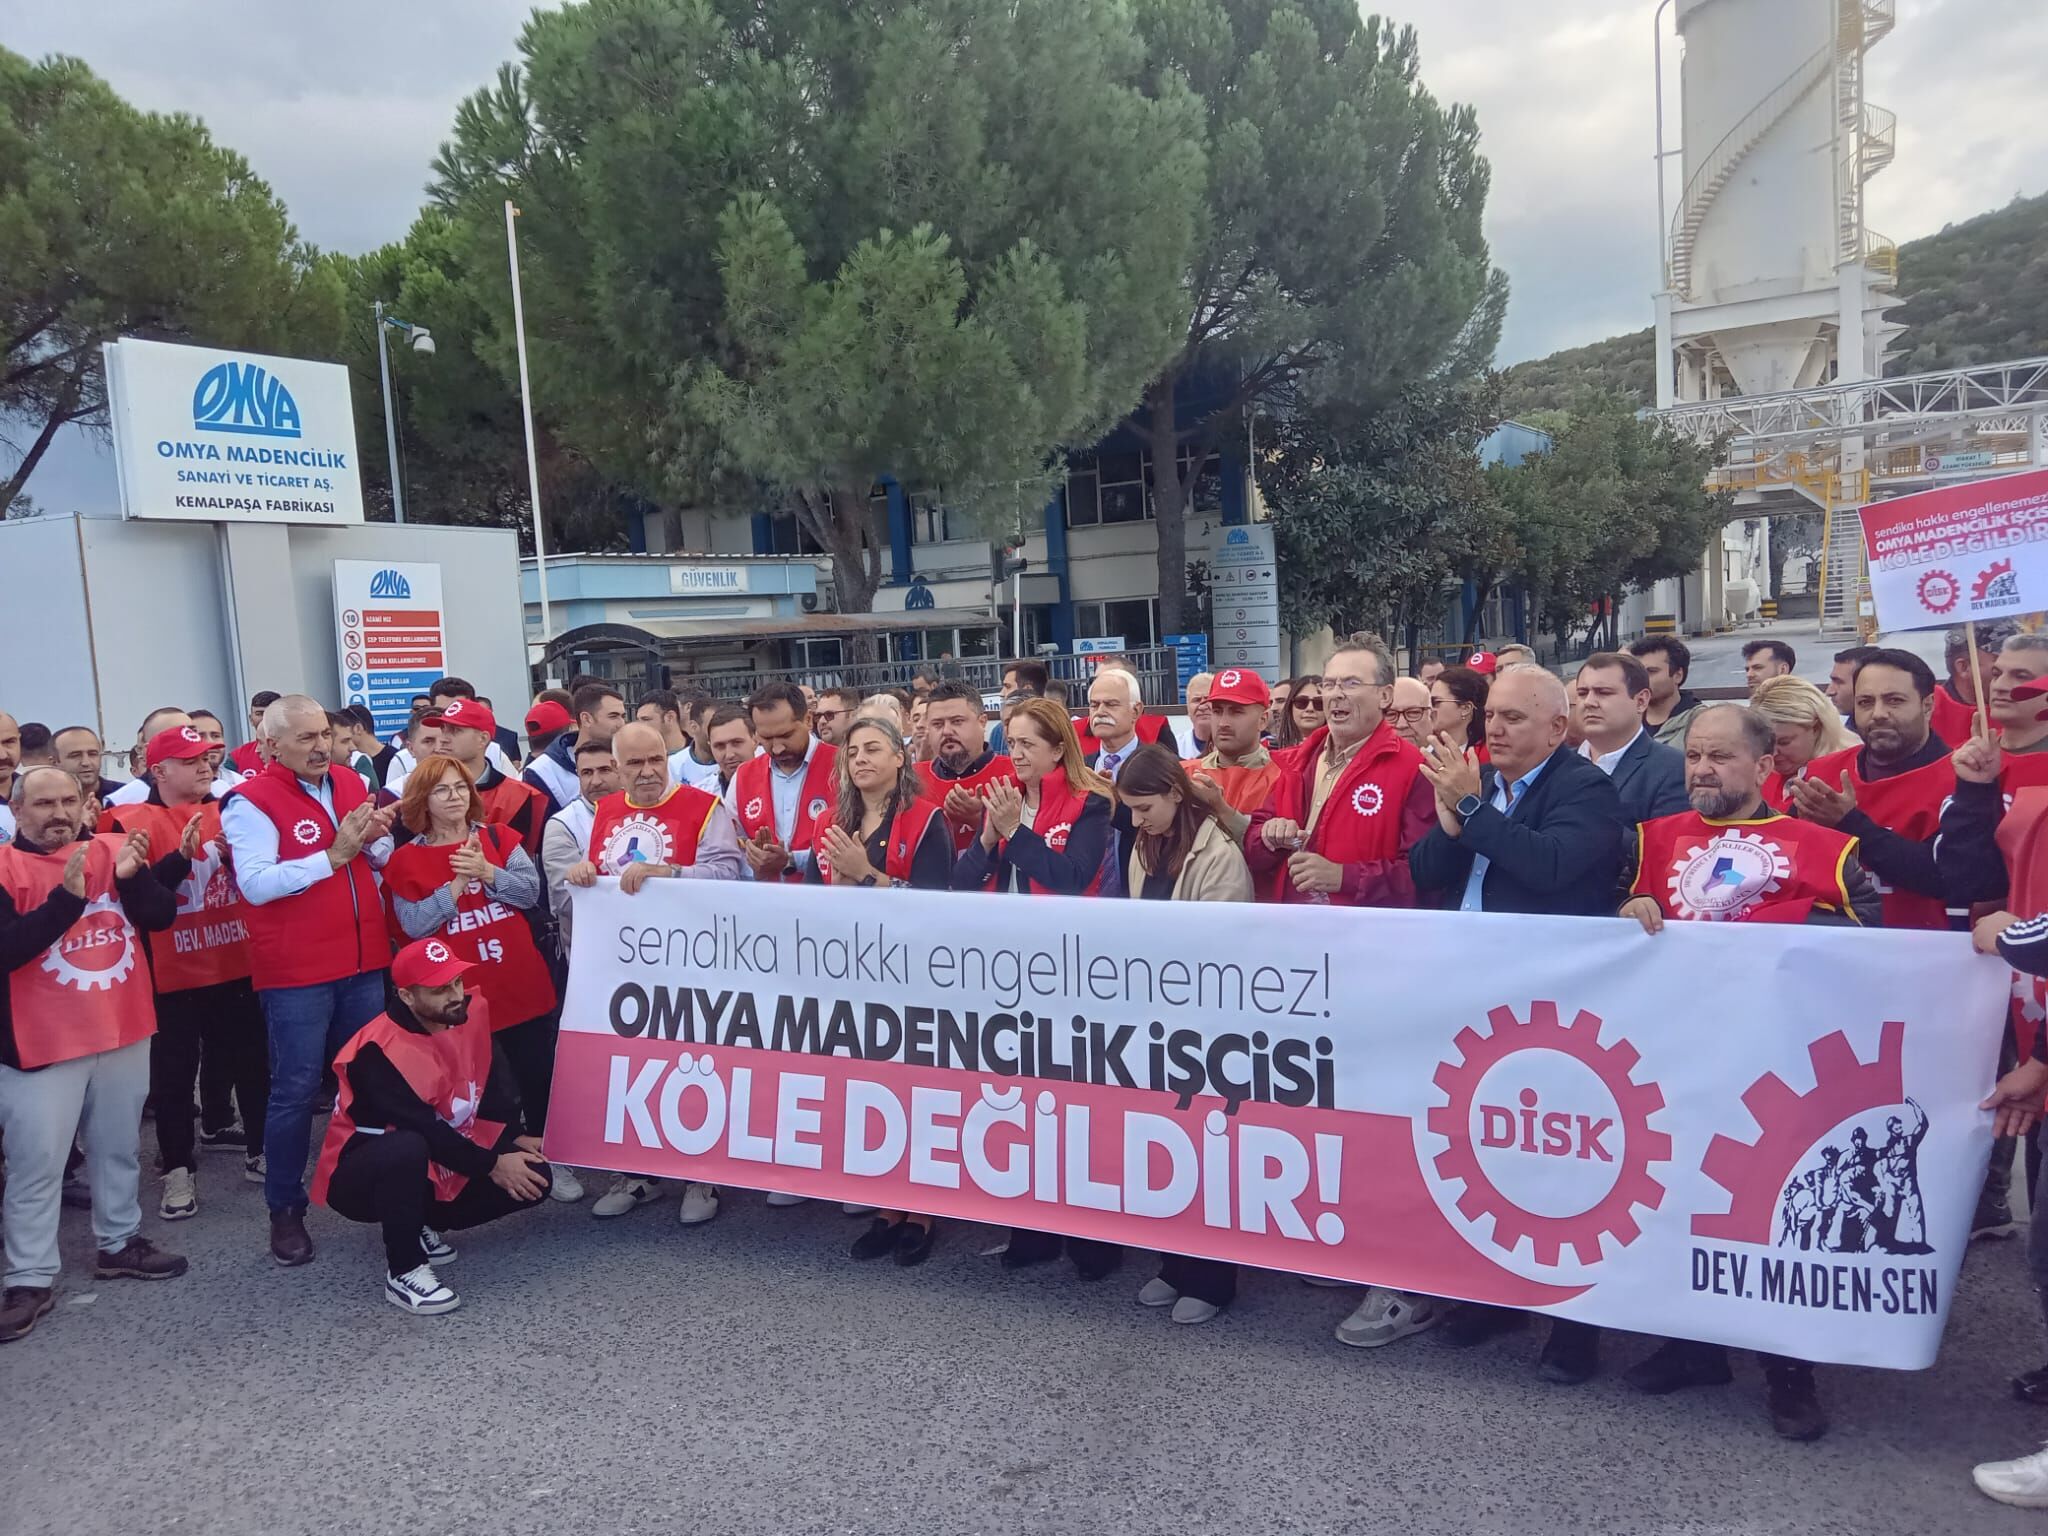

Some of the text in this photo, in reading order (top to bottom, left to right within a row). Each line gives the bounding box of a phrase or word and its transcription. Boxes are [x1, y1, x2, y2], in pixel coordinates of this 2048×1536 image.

[193, 362, 301, 438] OMYA
[157, 441, 346, 469] OMYA MADENCİLİK
[177, 470, 334, 492] SANAYİ VE TİCARET AŞ.
[176, 496, 334, 513] KEMALPAŞA FABRİKASI
[1875, 521, 1915, 539] sendika
[1916, 513, 1949, 530] hakkı
[1876, 535, 1914, 552] OMYA
[1914, 511, 2010, 545] MADENCİLİK
[1879, 545, 1934, 572] KÖLE
[370, 570, 411, 599] OMYA
[681, 567, 738, 587] GÜVENLİK
[346, 614, 355, 623] 10
[1358, 792, 1378, 805] DİSK
[1051, 835, 1067, 846] DİS
[173, 919, 249, 953] DEV. MADEN-
[477, 938, 503, 963] İŞ
[617, 914, 1331, 1018] sendika hakkı engellenemez!
[609, 981, 1335, 1115] OMYA MADENCİLİK İŞÇİSİ
[1479, 1087, 1614, 1163] DİSK
[603, 1051, 1346, 1247] KÖLE DEĞİLDİR!
[1691, 1246, 1938, 1315] DEV. MADEN-SEN
